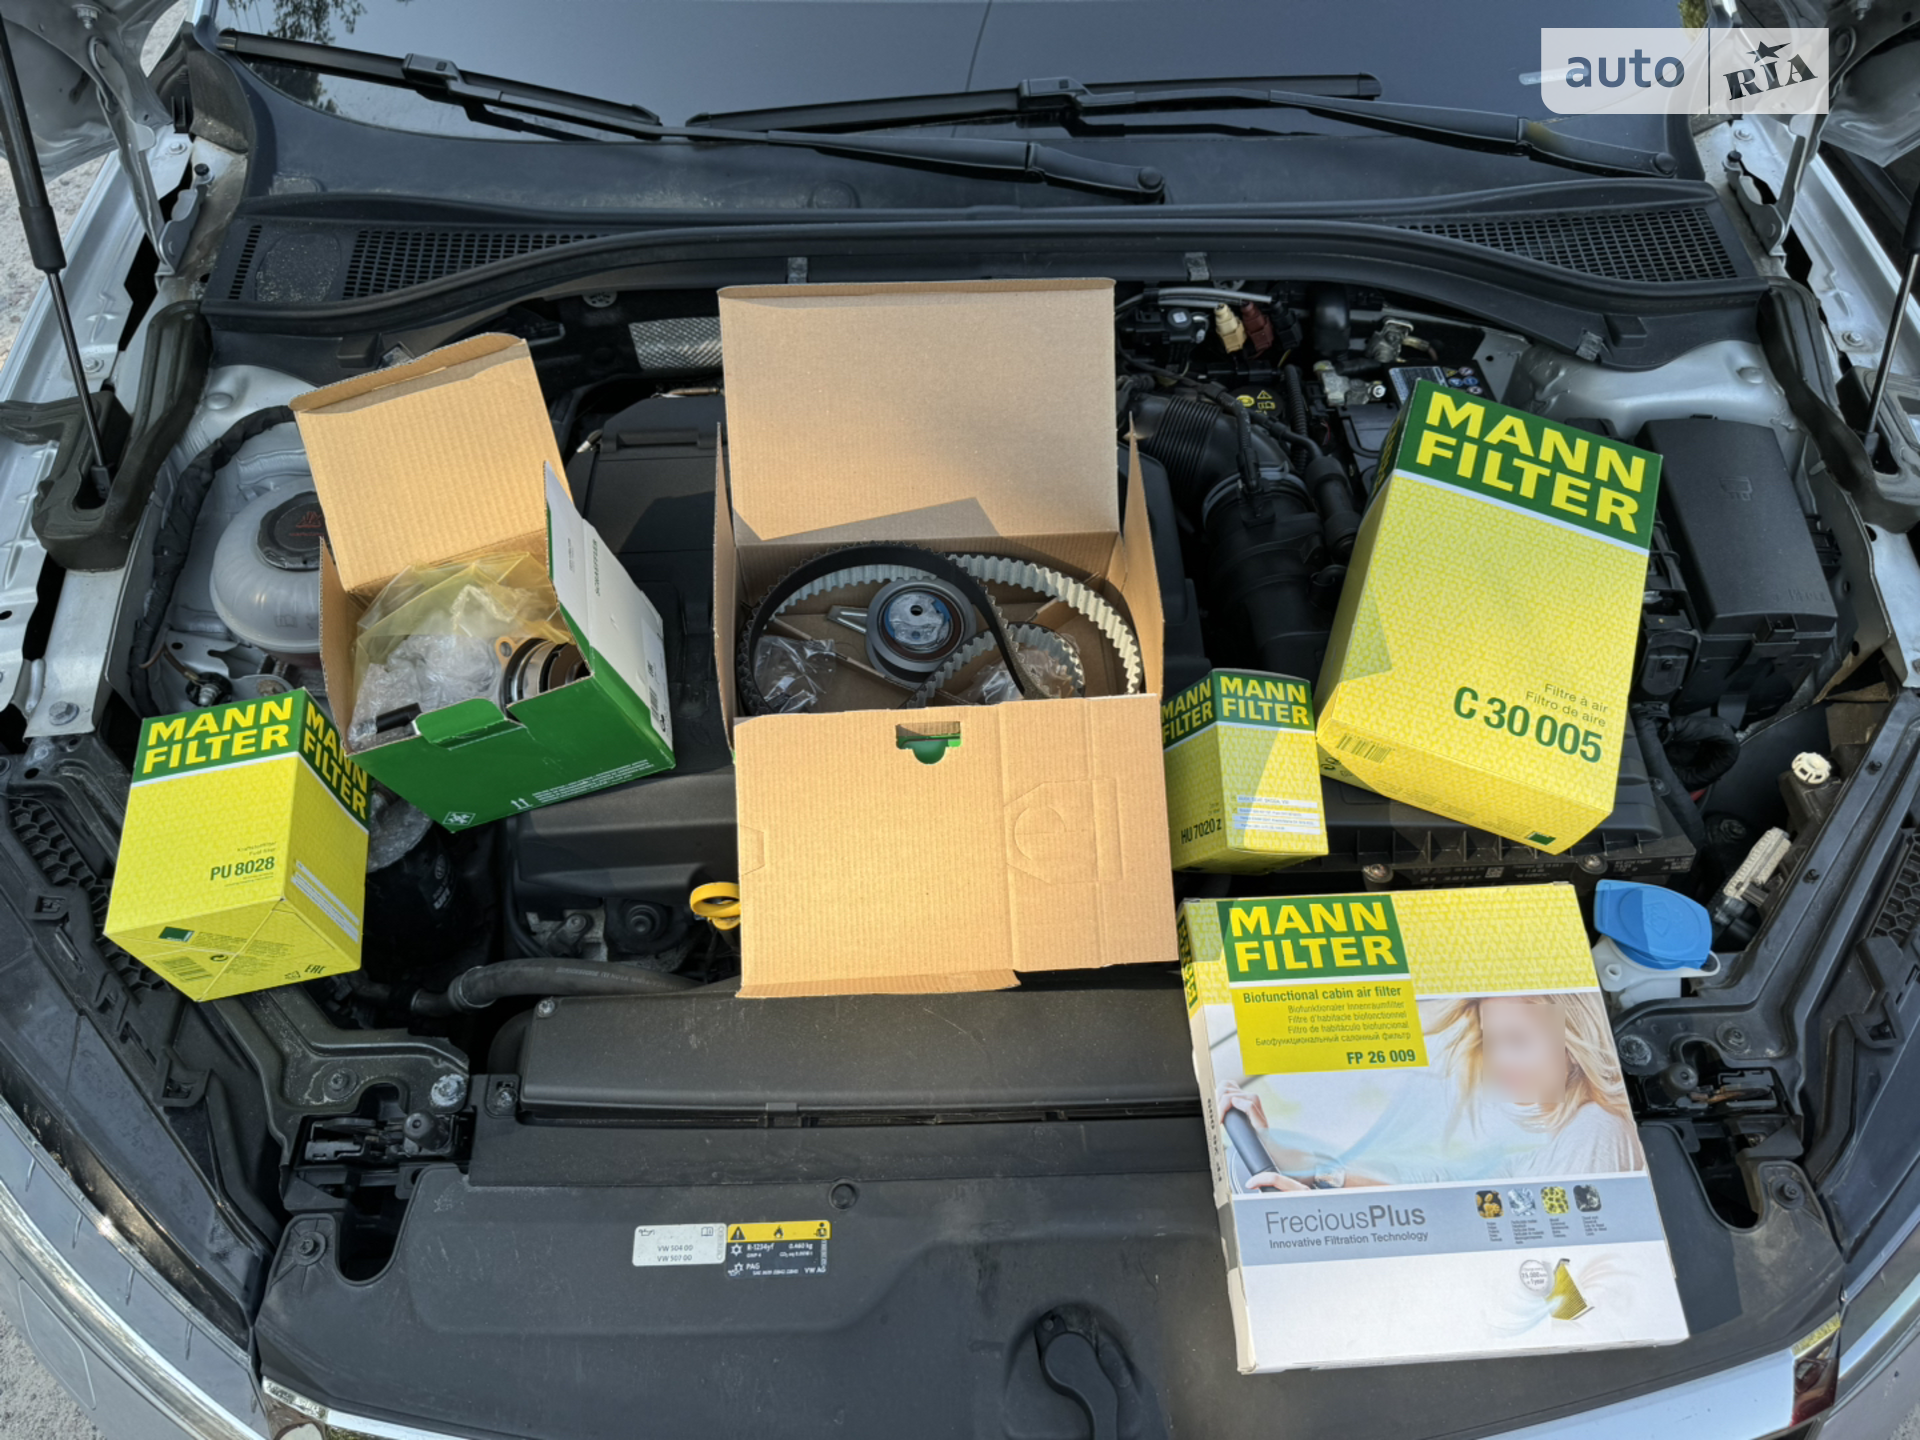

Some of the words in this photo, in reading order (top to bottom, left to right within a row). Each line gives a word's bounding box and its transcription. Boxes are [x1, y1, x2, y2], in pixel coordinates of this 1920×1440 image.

[1425, 391, 1645, 492] MANN
[1416, 429, 1638, 534] FILTER
[1161, 678, 1212, 724] MANN
[1220, 676, 1307, 703] MANN
[1544, 683, 1577, 702] Filtre
[1591, 702, 1609, 713] air
[147, 697, 293, 746] MANN
[1162, 701, 1214, 745] FILTER
[1222, 698, 1309, 726] FILTER
[1453, 686, 1479, 720] C
[1483, 696, 1530, 737] 30
[1535, 714, 1603, 764] 005
[1525, 690, 1558, 710] Filtro
[1562, 705, 1579, 718] de
[1582, 712, 1606, 727] aire
[142, 724, 290, 774] FILTER
[303, 728, 366, 820] FILTER
[1181, 826, 1193, 845] HU
[1193, 818, 1216, 839] 7020
[210, 864, 232, 881] PU
[234, 856, 275, 876] 8028
[1229, 902, 1389, 937] MANN
[1234, 935, 1398, 973] FILTER
[1243, 989, 1319, 1003] Biofunctional
[1322, 988, 1354, 1000] cabin
[1357, 987, 1371, 998] air
[1375, 986, 1401, 997] filter
[1346, 1052, 1363, 1065] FP
[1368, 1050, 1386, 1063] 26
[1389, 1049, 1416, 1062] 009
[1265, 1205, 1426, 1234] FreciousPlus
[1269, 1236, 1322, 1249] Innovative
[1324, 1234, 1369, 1245] Filtration
[1371, 1230, 1429, 1243] Technology
